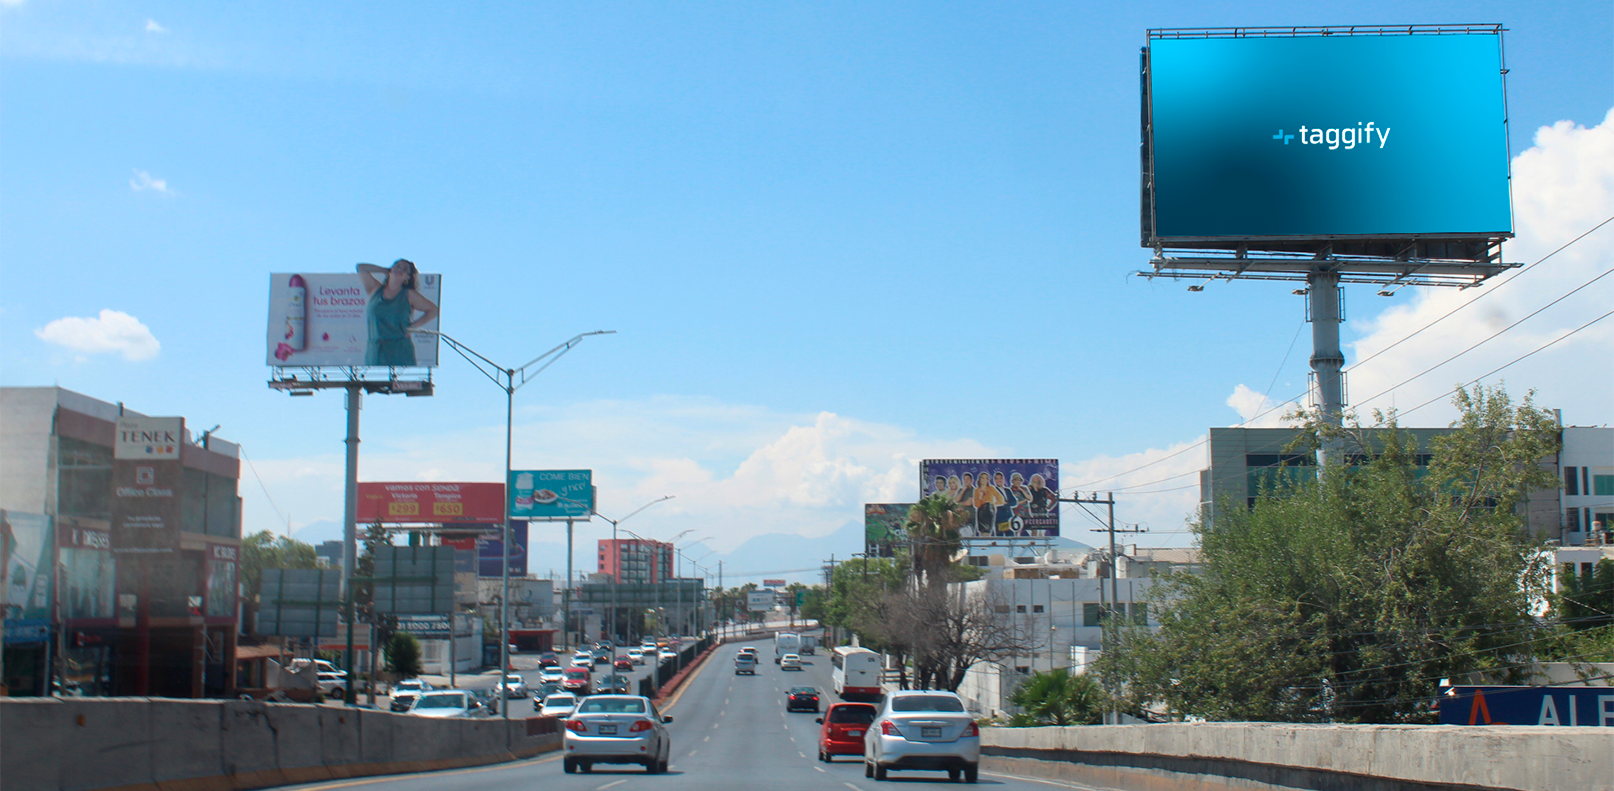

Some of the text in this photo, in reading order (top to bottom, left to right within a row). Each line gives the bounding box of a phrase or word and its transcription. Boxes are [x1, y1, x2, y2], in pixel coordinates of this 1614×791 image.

[1299, 121, 1391, 150] taggify
[319, 285, 361, 296] Levanta
[313, 296, 329, 306] tus
[331, 295, 366, 306] brazos
[120, 430, 176, 443] TENEK
[539, 472, 589, 481] COME BIEN
[415, 484, 430, 492] con
[1010, 515, 1021, 531] 6
